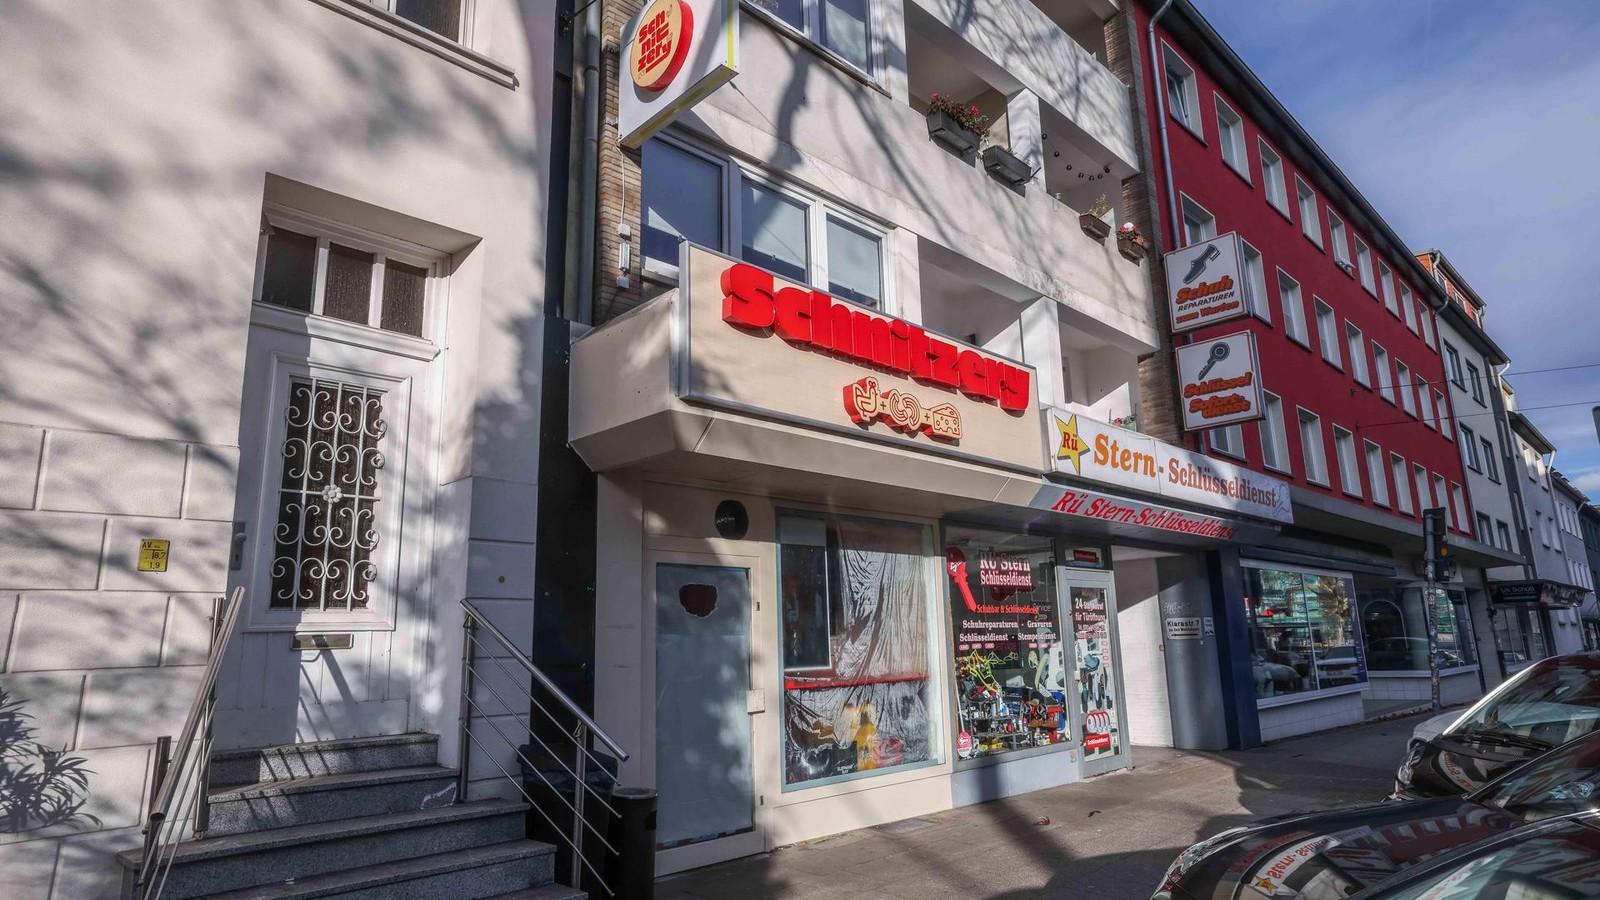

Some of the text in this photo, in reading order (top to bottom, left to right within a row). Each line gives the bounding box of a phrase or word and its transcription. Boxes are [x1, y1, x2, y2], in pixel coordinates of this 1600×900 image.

[1176, 274, 1234, 305] Schuh
[1177, 291, 1235, 312] REPARATUREN
[720, 262, 1030, 411] Schnitzery
[1062, 431, 1079, 452] Rü
[1168, 457, 1277, 508] Schlüsseldienst
[1051, 491, 1088, 514] Rü
[1000, 552, 1031, 572] Stern
[980, 569, 1032, 586] Schlüsseldienst
[962, 619, 1052, 630] Schuhreparaturen Gravuren
[960, 632, 1056, 642] Schlüsseldienst Stempeldienst
